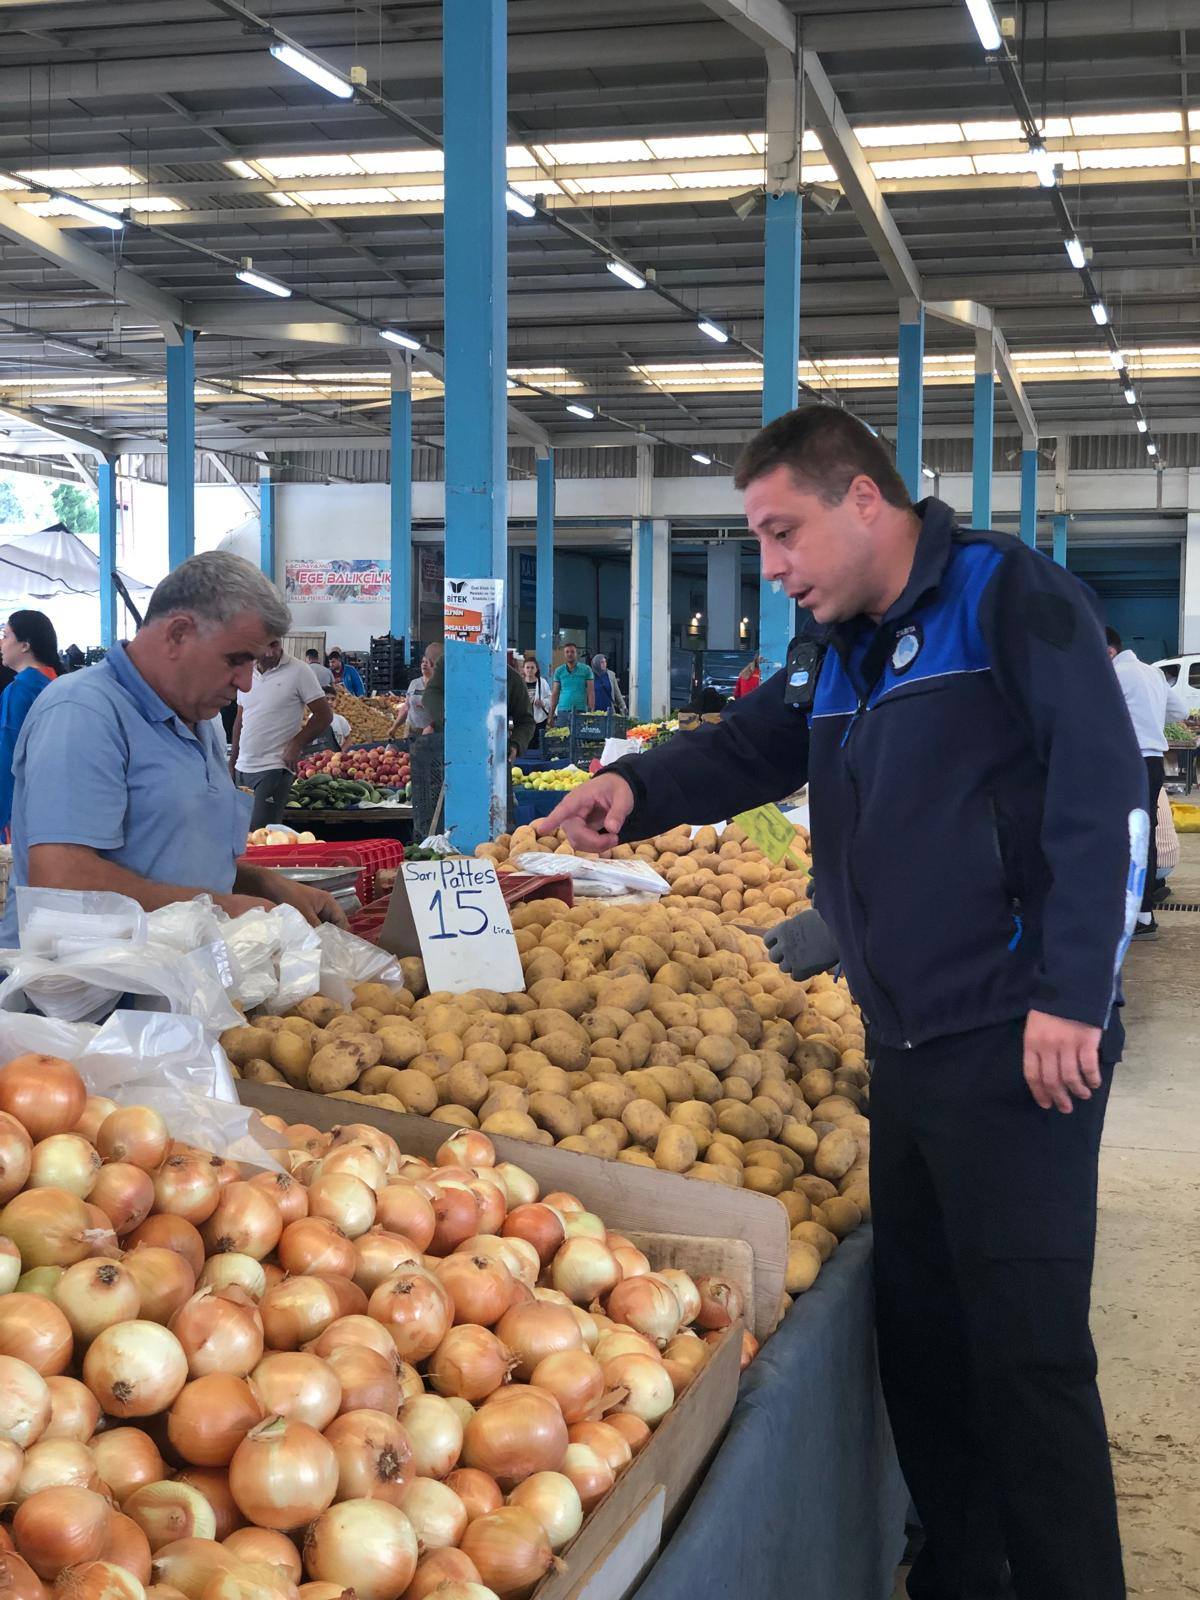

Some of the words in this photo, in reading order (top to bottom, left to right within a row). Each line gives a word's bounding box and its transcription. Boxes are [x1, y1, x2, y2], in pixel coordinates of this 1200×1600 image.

[300, 573, 324, 584] EGE
[446, 594, 468, 603] BİTEK
[440, 860, 496, 890] Pattes
[428, 889, 489, 940] 15
